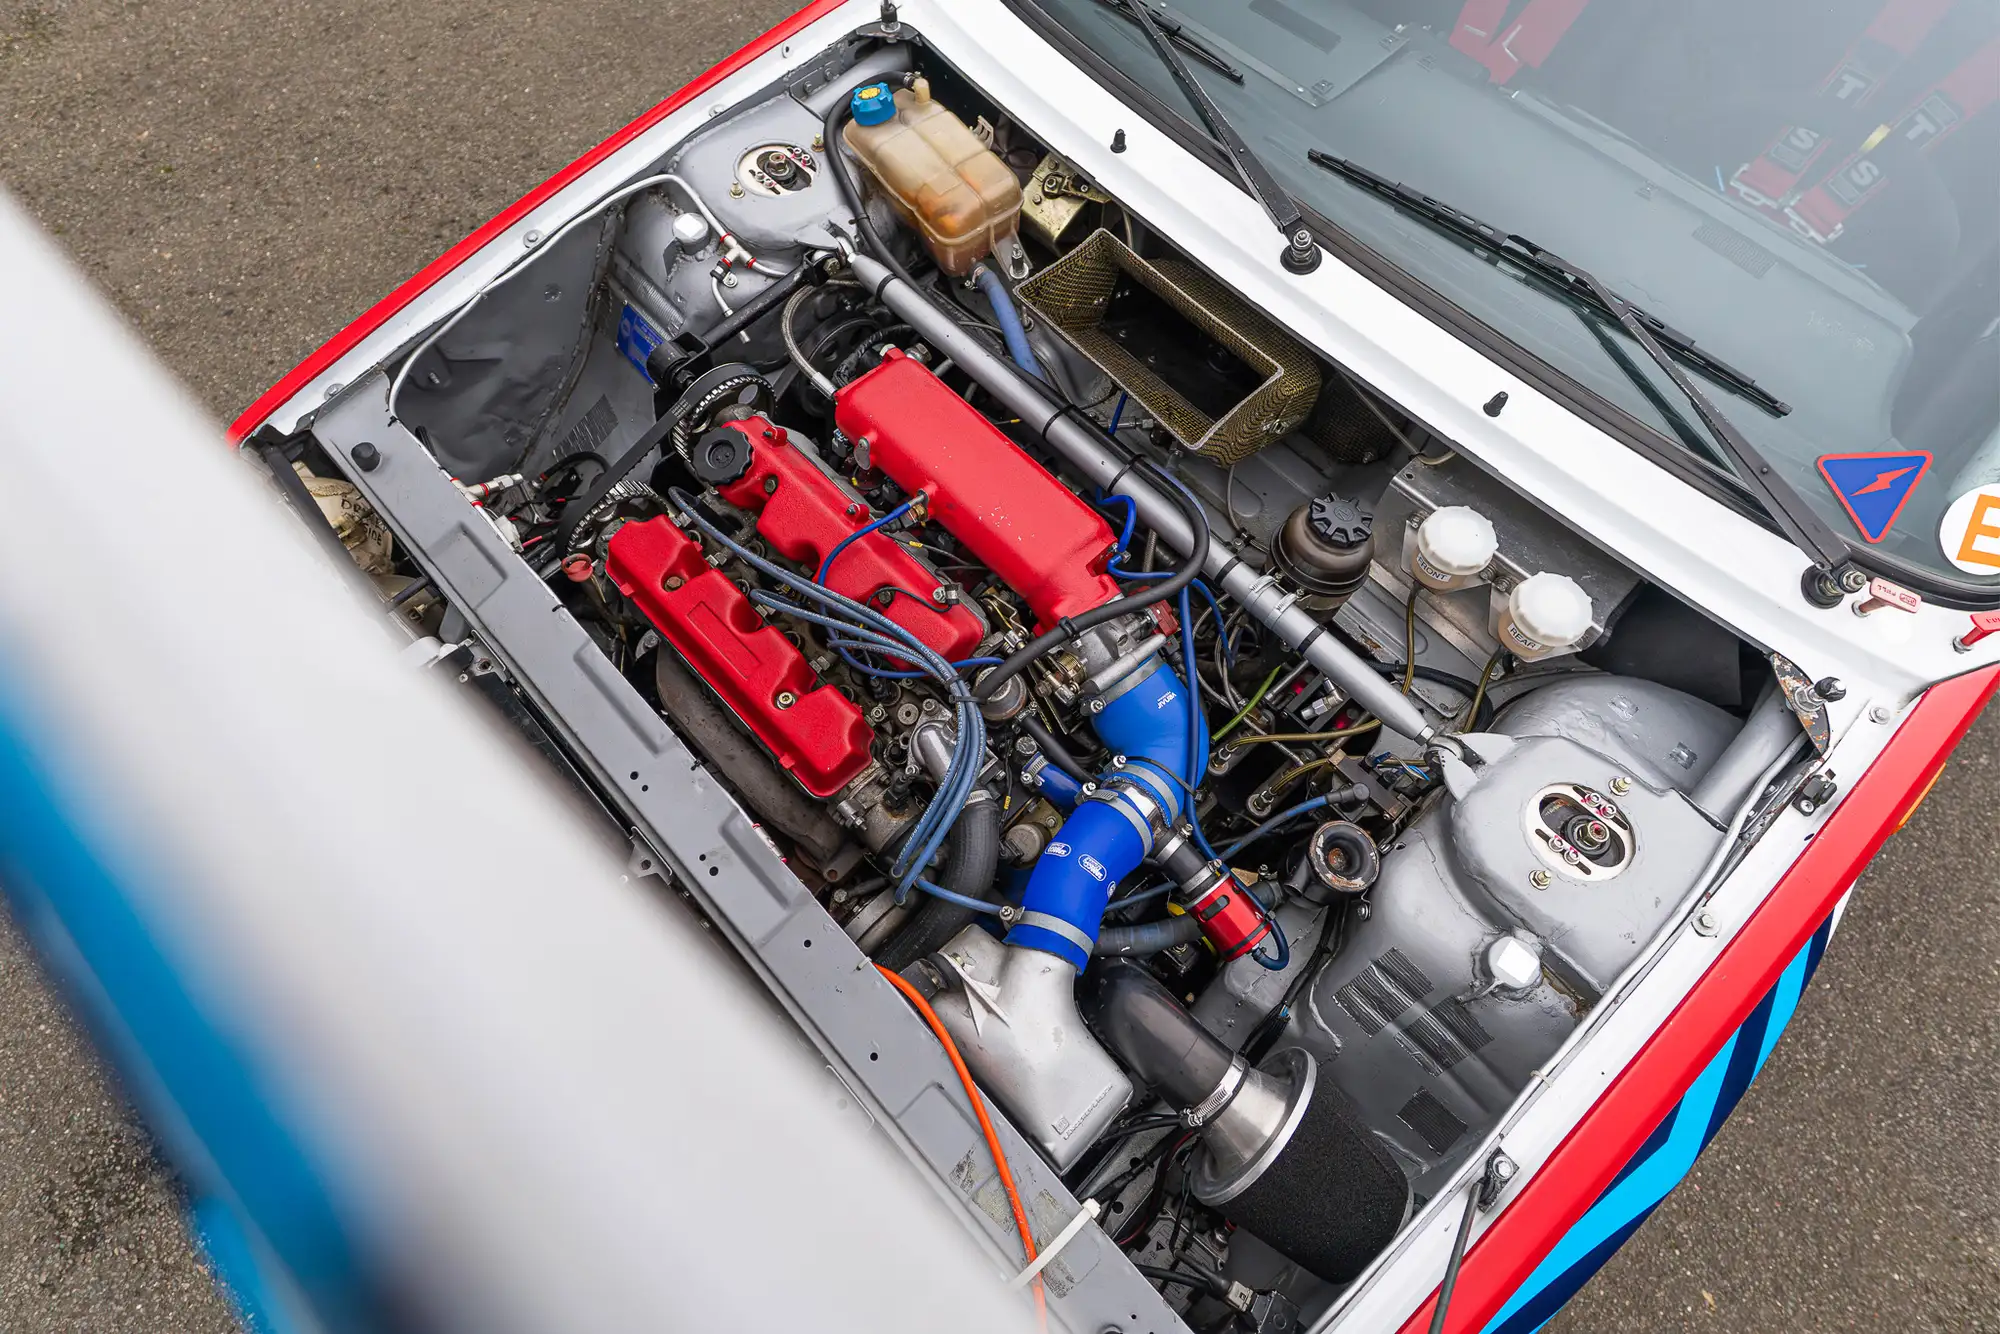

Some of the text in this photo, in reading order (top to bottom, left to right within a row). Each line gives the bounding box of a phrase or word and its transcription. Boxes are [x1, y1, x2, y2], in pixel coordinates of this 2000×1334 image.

[1418, 556, 1448, 580] FRONT
[1510, 627, 1537, 649] REAR
[920, 644, 939, 664] LUCAS
